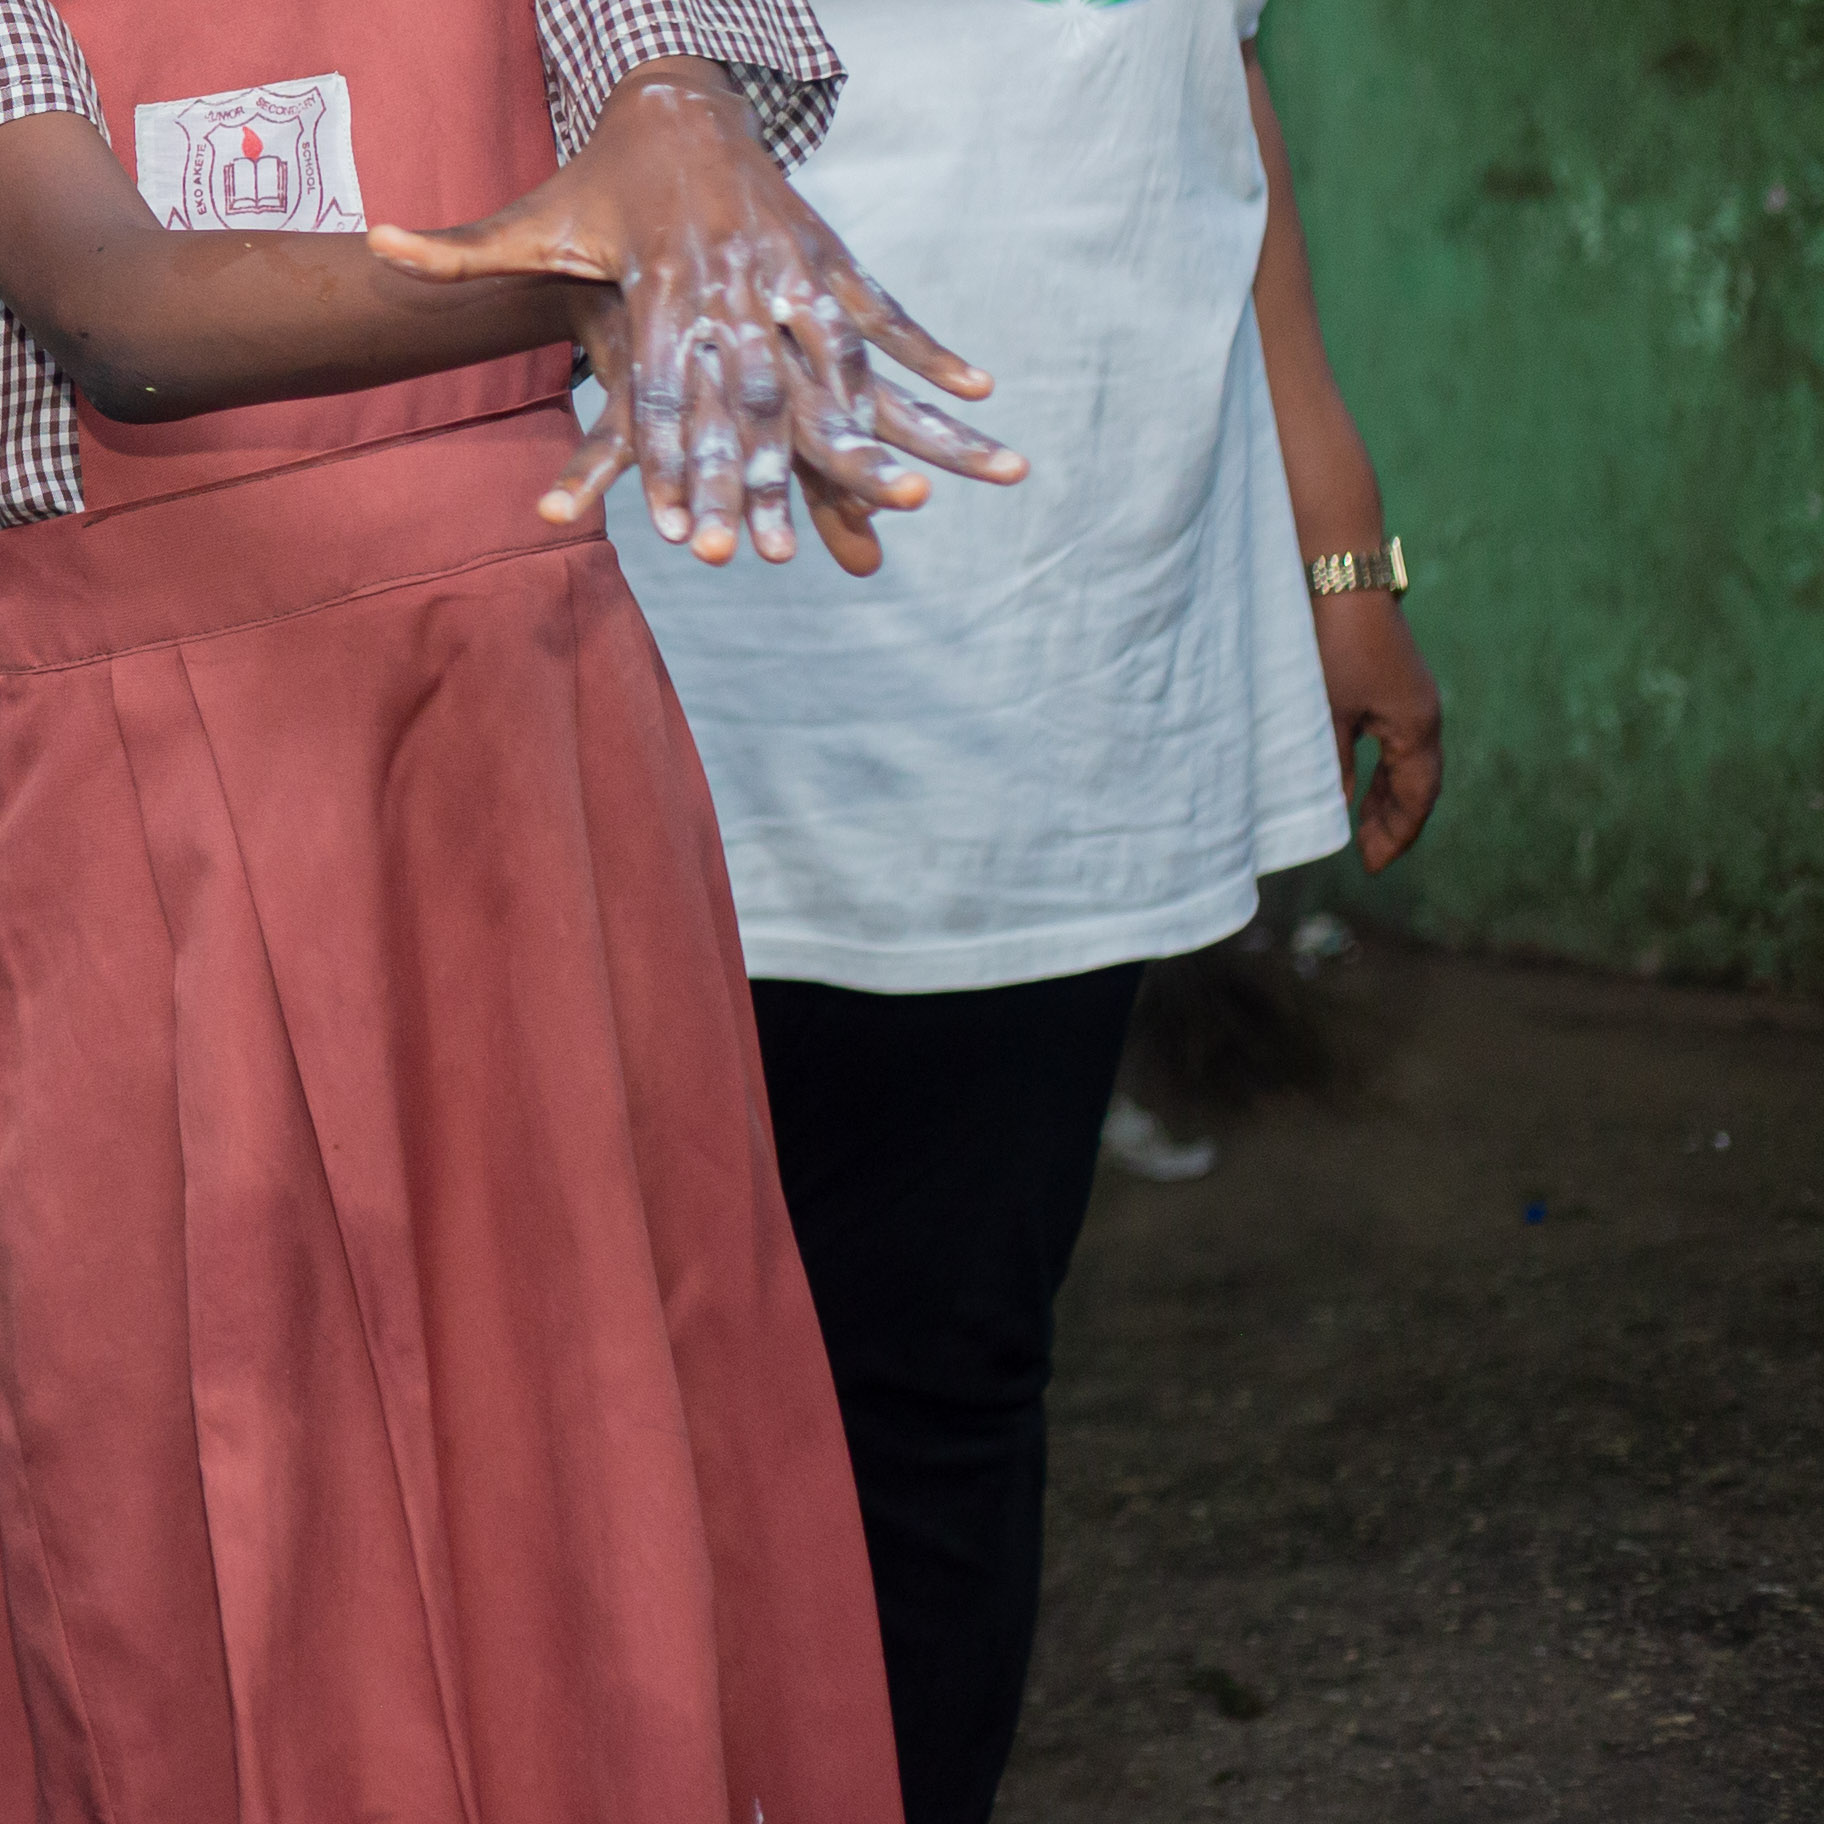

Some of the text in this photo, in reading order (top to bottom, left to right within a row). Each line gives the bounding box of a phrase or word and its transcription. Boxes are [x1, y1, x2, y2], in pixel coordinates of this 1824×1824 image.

[193, 143, 207, 215] EKO AKETE
[302, 141, 316, 195] SCHOOL
